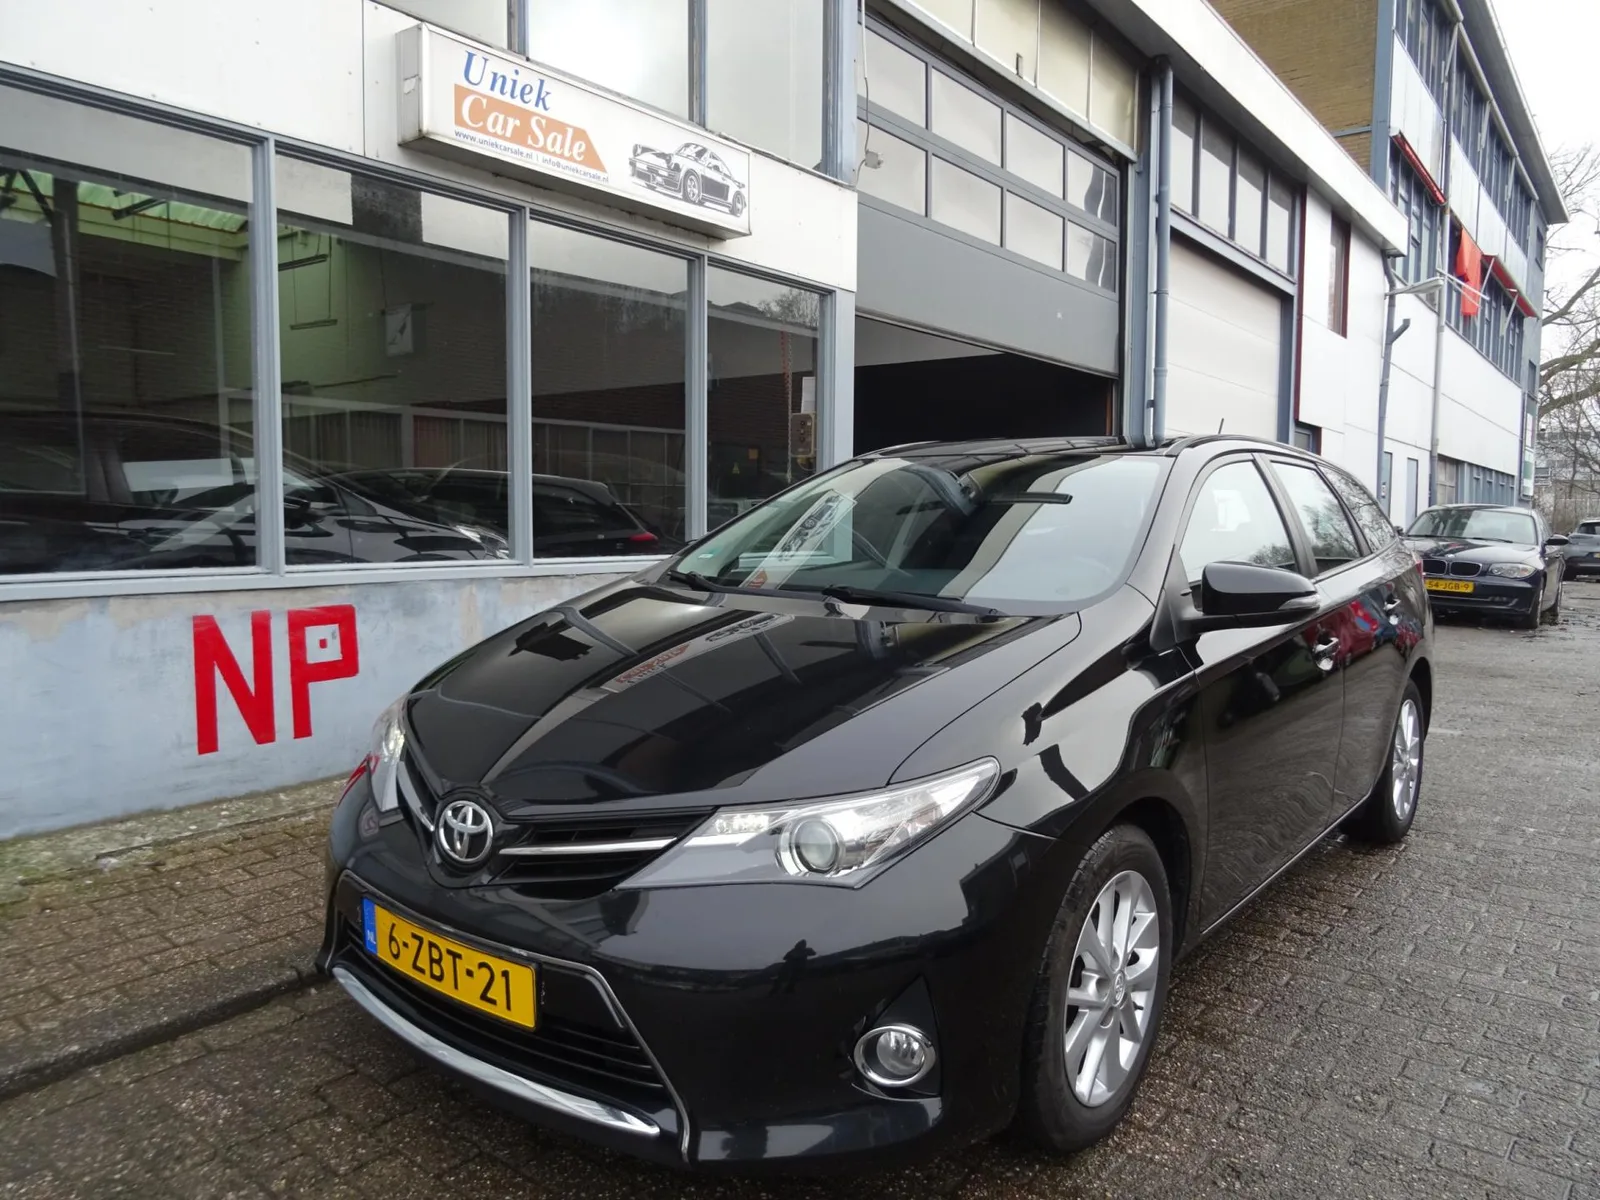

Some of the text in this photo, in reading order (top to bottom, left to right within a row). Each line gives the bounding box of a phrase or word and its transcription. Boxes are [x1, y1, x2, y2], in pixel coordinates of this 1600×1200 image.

[463, 51, 551, 111] Uniek
[455, 130, 533, 160] www.uniekcarsale.nl
[542, 157, 609, 183] info@uniekcarsale.nl
[461, 94, 586, 161] Car Sale
[192, 604, 359, 755] NP
[388, 922, 512, 1012] 6-ZBT-21
